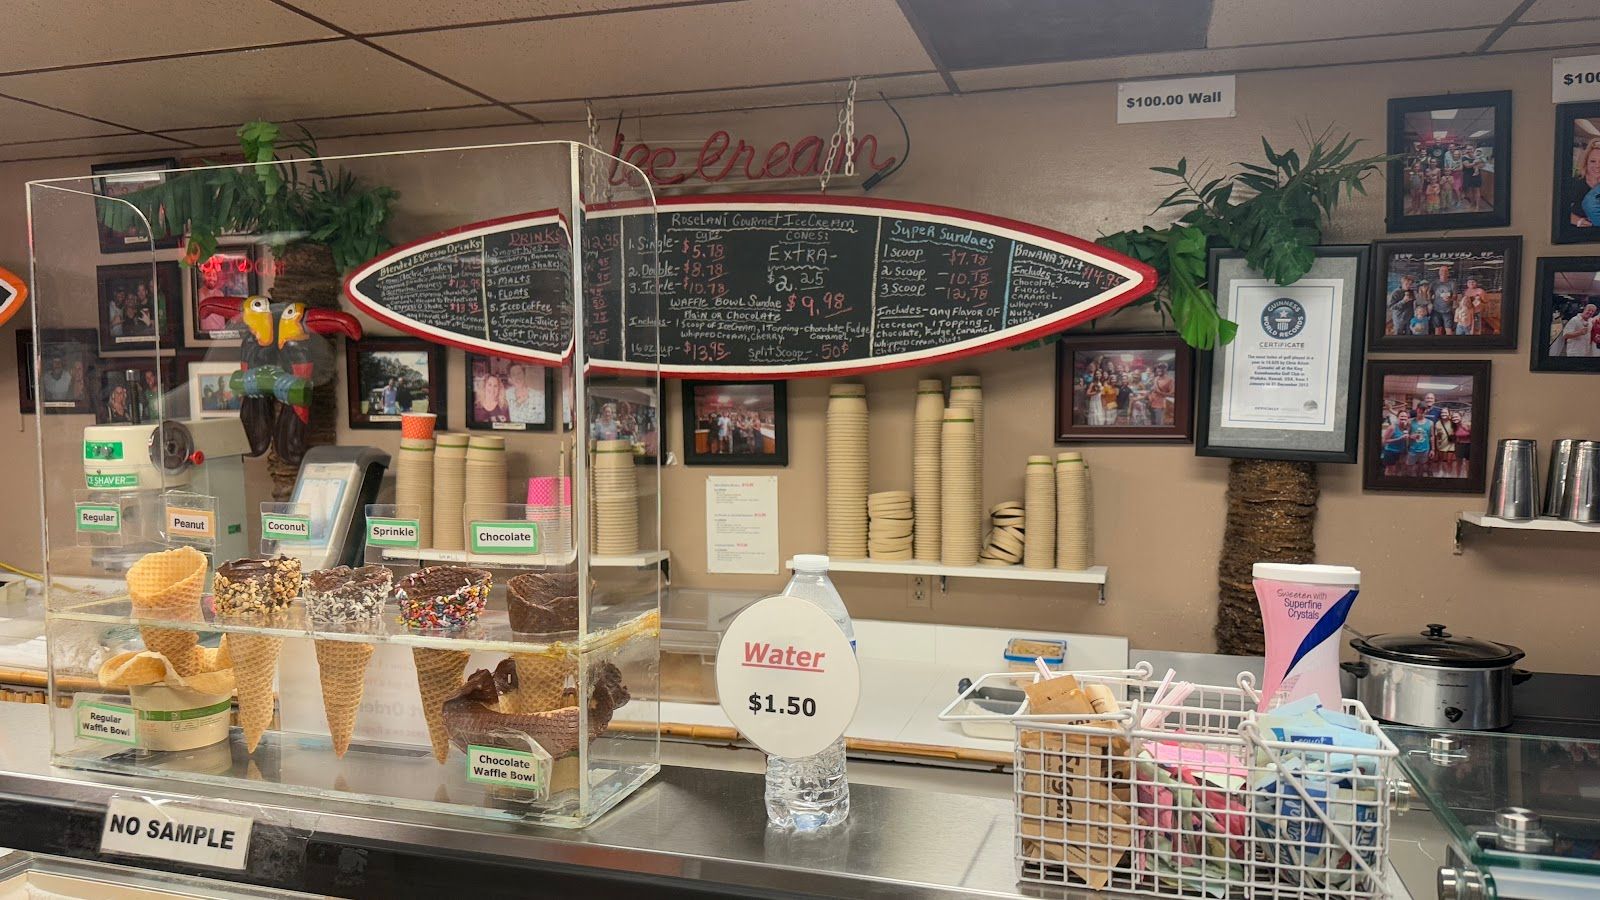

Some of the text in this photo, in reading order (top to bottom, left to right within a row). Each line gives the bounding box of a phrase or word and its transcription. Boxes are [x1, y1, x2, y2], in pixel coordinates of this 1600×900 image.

[1126, 91, 1222, 109] $100.00 Wall
[939, 227, 996, 250] Sundaes
[881, 265, 892, 276] 2
[487, 277, 496, 287] 3.
[880, 283, 889, 295] 3
[490, 303, 499, 312] 5.
[1267, 299, 1300, 313] GUINNESS
[1263, 315, 1304, 338] WORLD RECORDS
[1259, 341, 1305, 349] CERTIFICATE
[94, 475, 126, 485] SHAVER
[82, 513, 115, 524] Regular
[174, 518, 205, 530] Peanut
[268, 521, 306, 532] Coconut
[373, 526, 415, 537] Sprinkle
[479, 532, 531, 541] Chocolate
[1276, 588, 1328, 600] Sweeten with
[1284, 597, 1322, 610] Superfine
[1287, 607, 1320, 620] Crystals
[743, 641, 826, 669] Water
[748, 692, 817, 717] $1.50
[90, 712, 122, 724] Regular
[82, 723, 130, 737] Waffle Bowl
[479, 754, 531, 769] Chocolate
[473, 766, 536, 782] Waffle Bowl
[109, 814, 236, 850] NO SAMPLE
